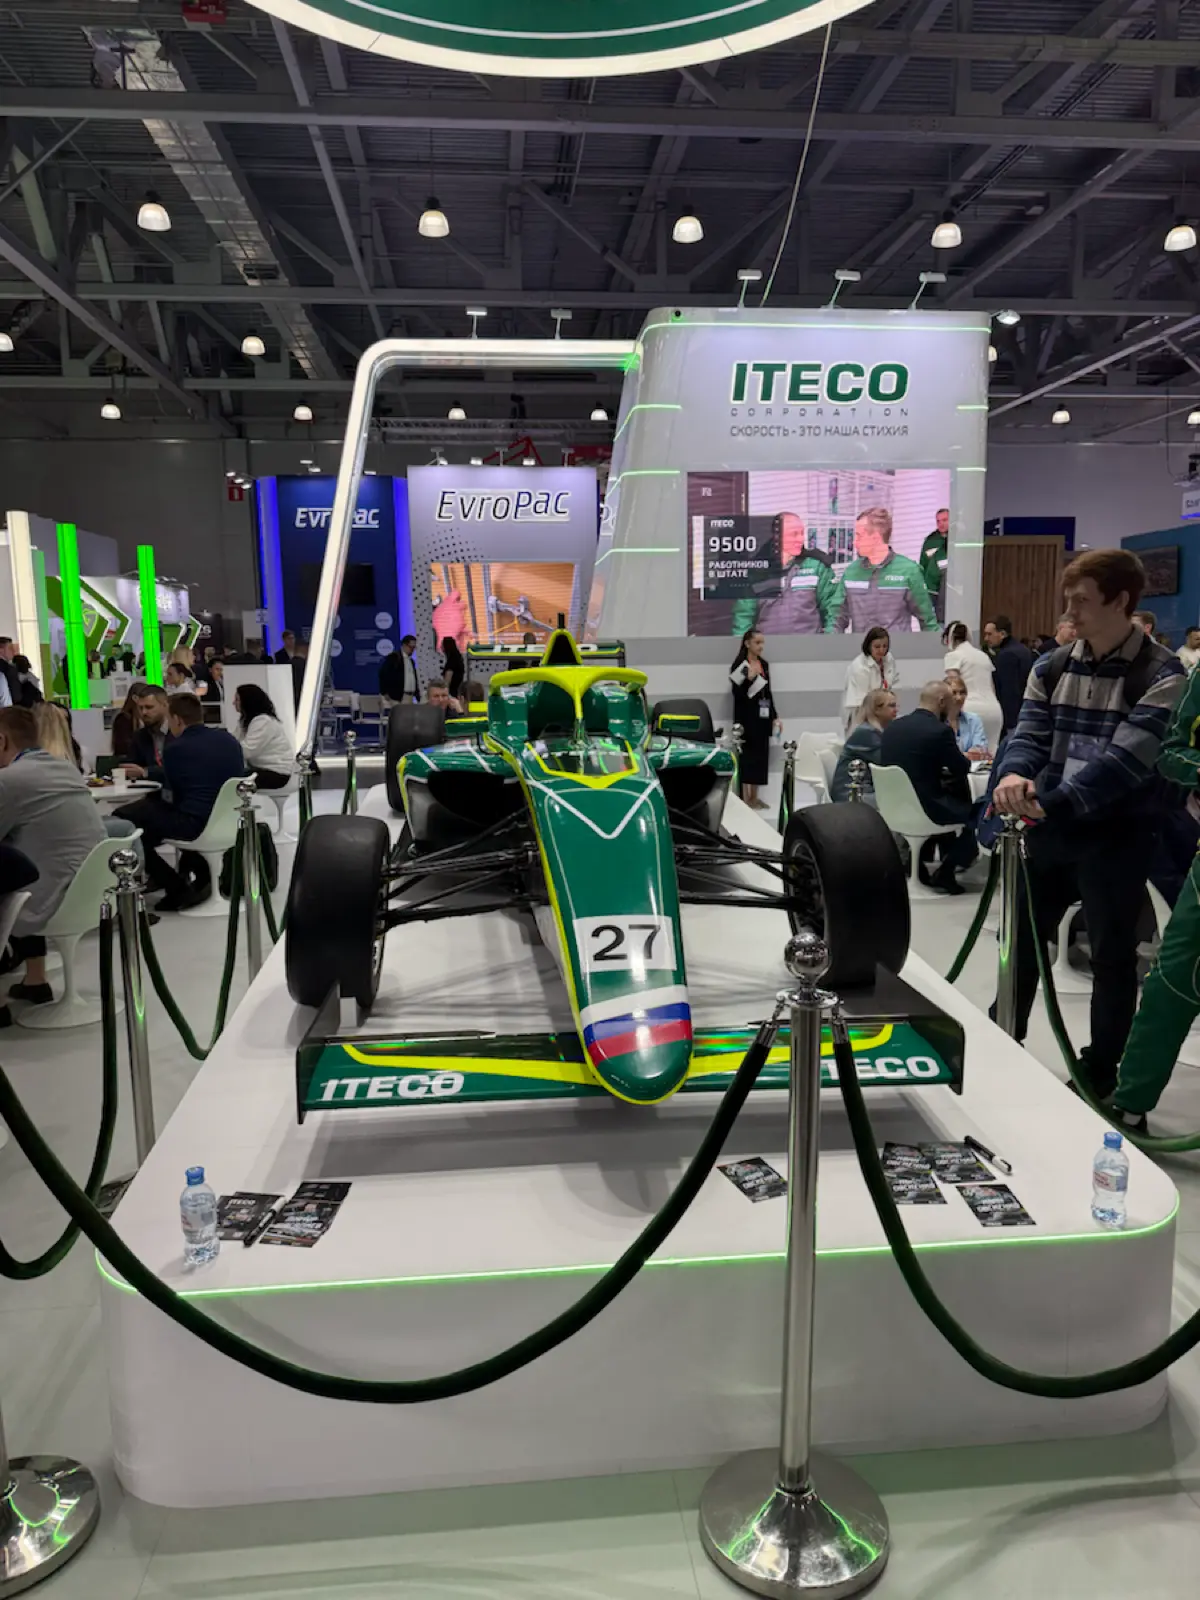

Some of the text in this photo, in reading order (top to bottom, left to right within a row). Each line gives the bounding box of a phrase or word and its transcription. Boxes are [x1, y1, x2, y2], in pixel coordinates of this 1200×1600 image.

[731, 362, 909, 404] ITECO
[730, 407, 909, 417] CORPORATION
[730, 424, 790, 437] СКОРОСТЬ
[799, 425, 822, 437] ЭТО
[824, 425, 860, 437] НАША
[862, 424, 909, 437] СТИХИЯ
[436, 489, 570, 521] EvroPac
[295, 507, 380, 529] Evrac
[708, 535, 757, 553] 9500
[708, 560, 769, 569] РАБОТНИКОВ
[708, 570, 749, 578] В ШТАТЕ
[591, 924, 661, 962] 27
[821, 1055, 941, 1081] TECO
[320, 1071, 465, 1102] ITECO
